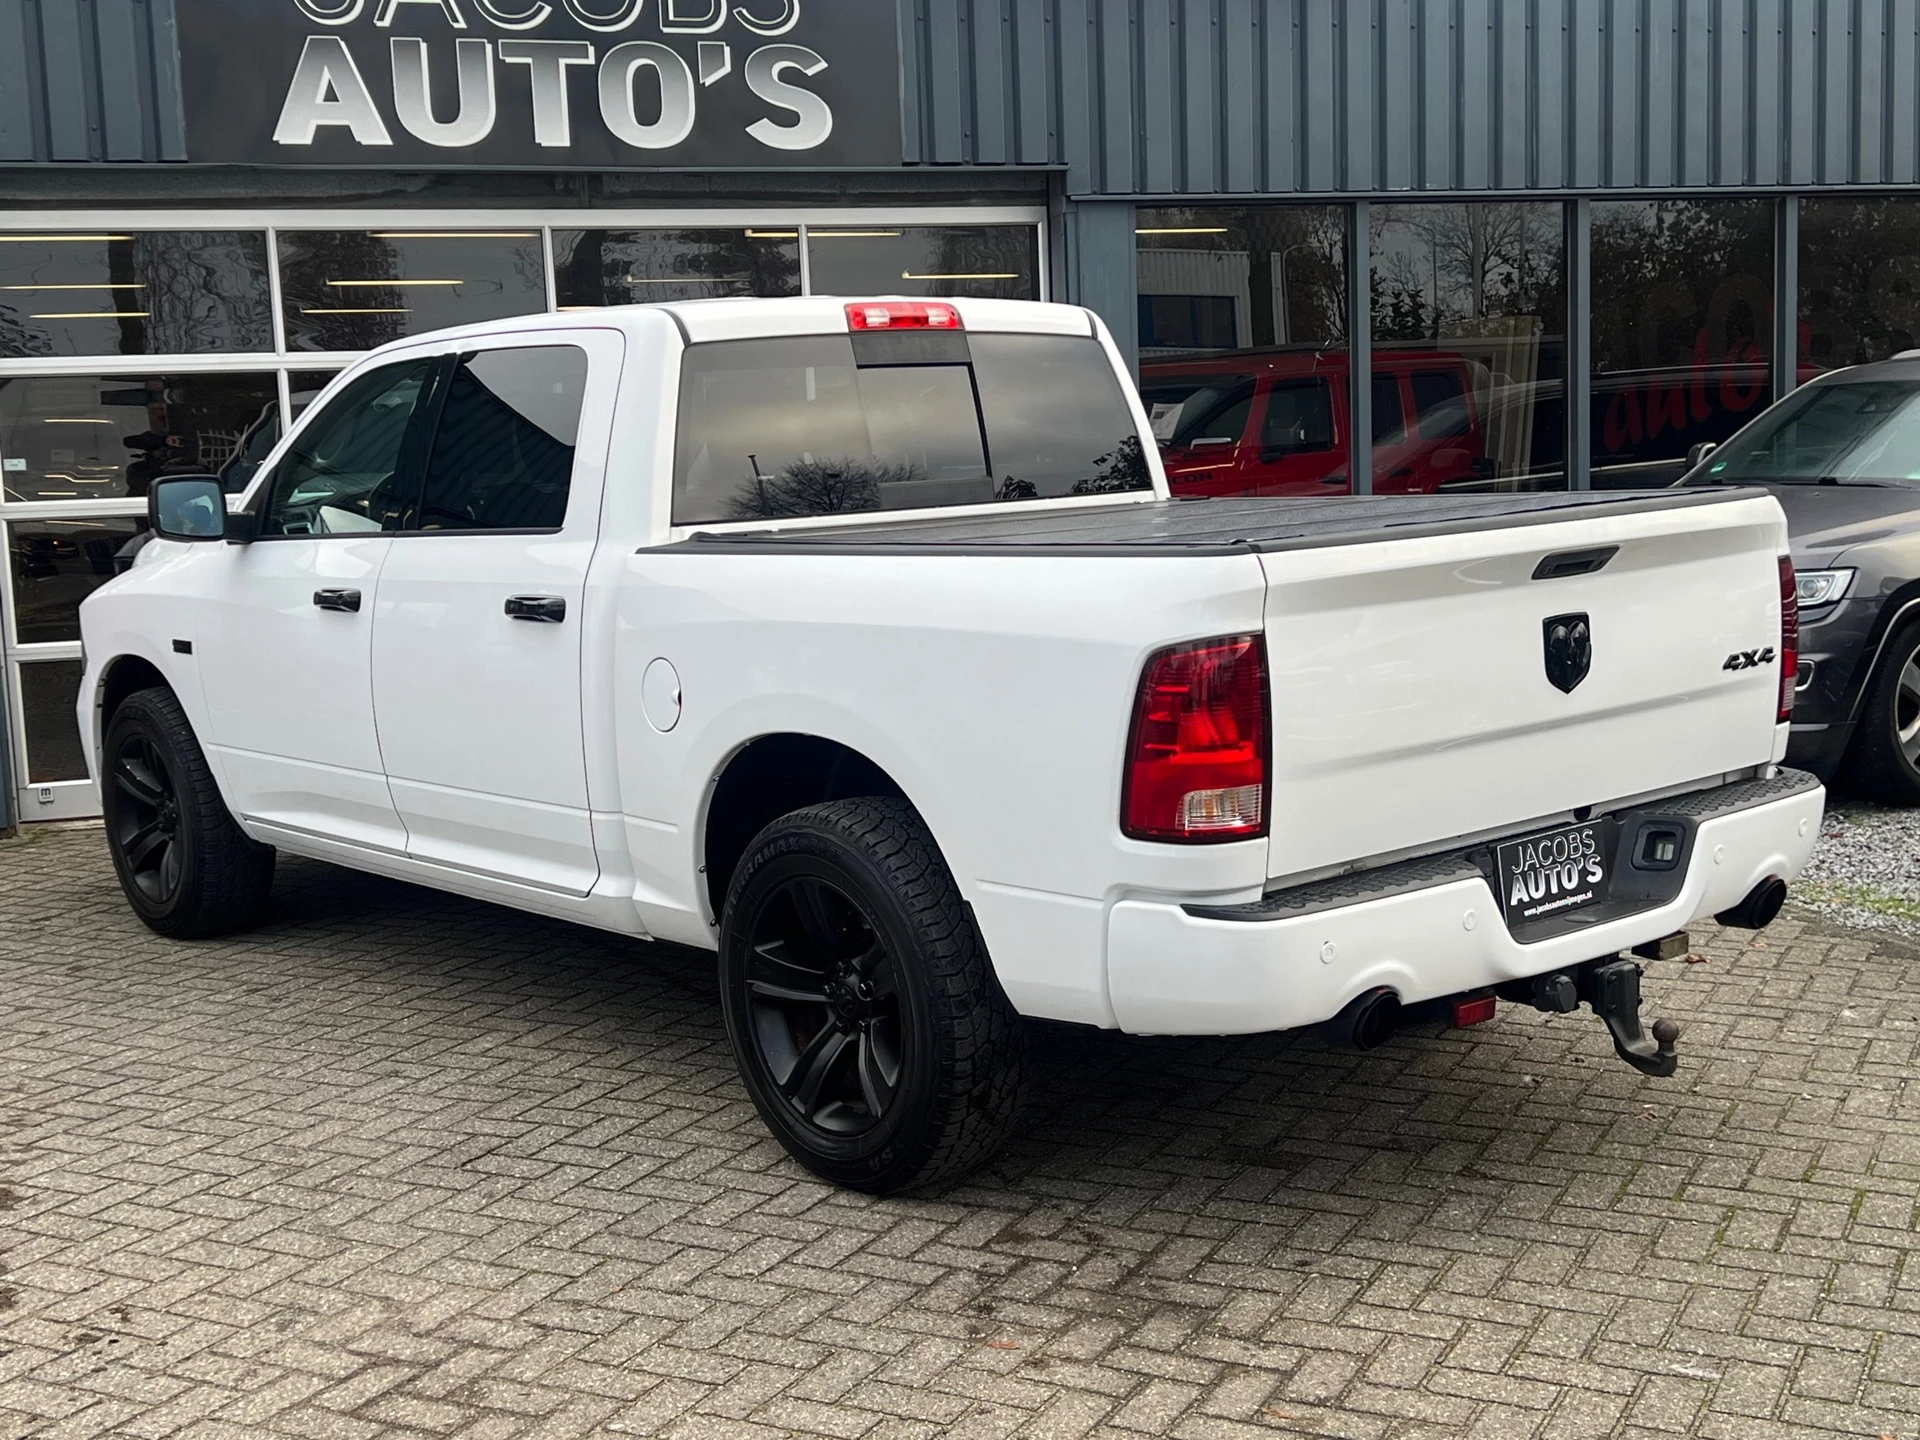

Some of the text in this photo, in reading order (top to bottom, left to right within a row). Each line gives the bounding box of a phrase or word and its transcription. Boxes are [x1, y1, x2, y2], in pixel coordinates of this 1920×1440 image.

[272, 34, 833, 150] AUTO'S
[1511, 829, 1595, 873] JACOBS
[1510, 854, 1603, 906] AUTO'S
